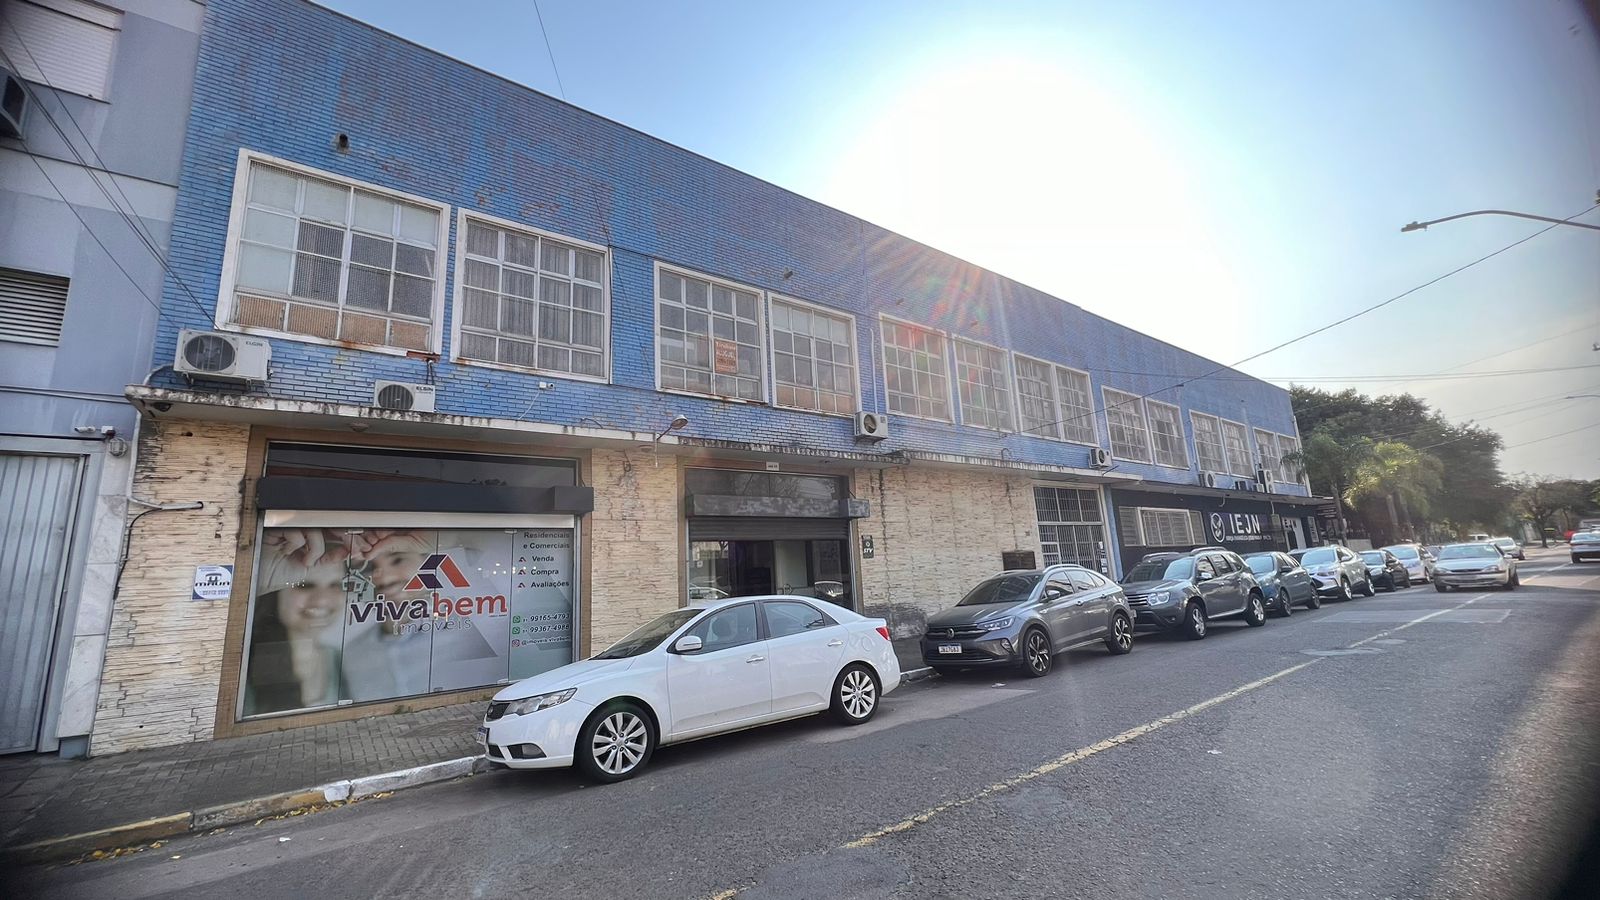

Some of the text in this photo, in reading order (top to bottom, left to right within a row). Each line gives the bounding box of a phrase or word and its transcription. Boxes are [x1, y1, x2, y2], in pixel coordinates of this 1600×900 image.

[1229, 513, 1261, 534] IEJN
[523, 531, 570, 539] Residenciais
[530, 580, 570, 589] Avaliações
[350, 592, 508, 624] vivabem
